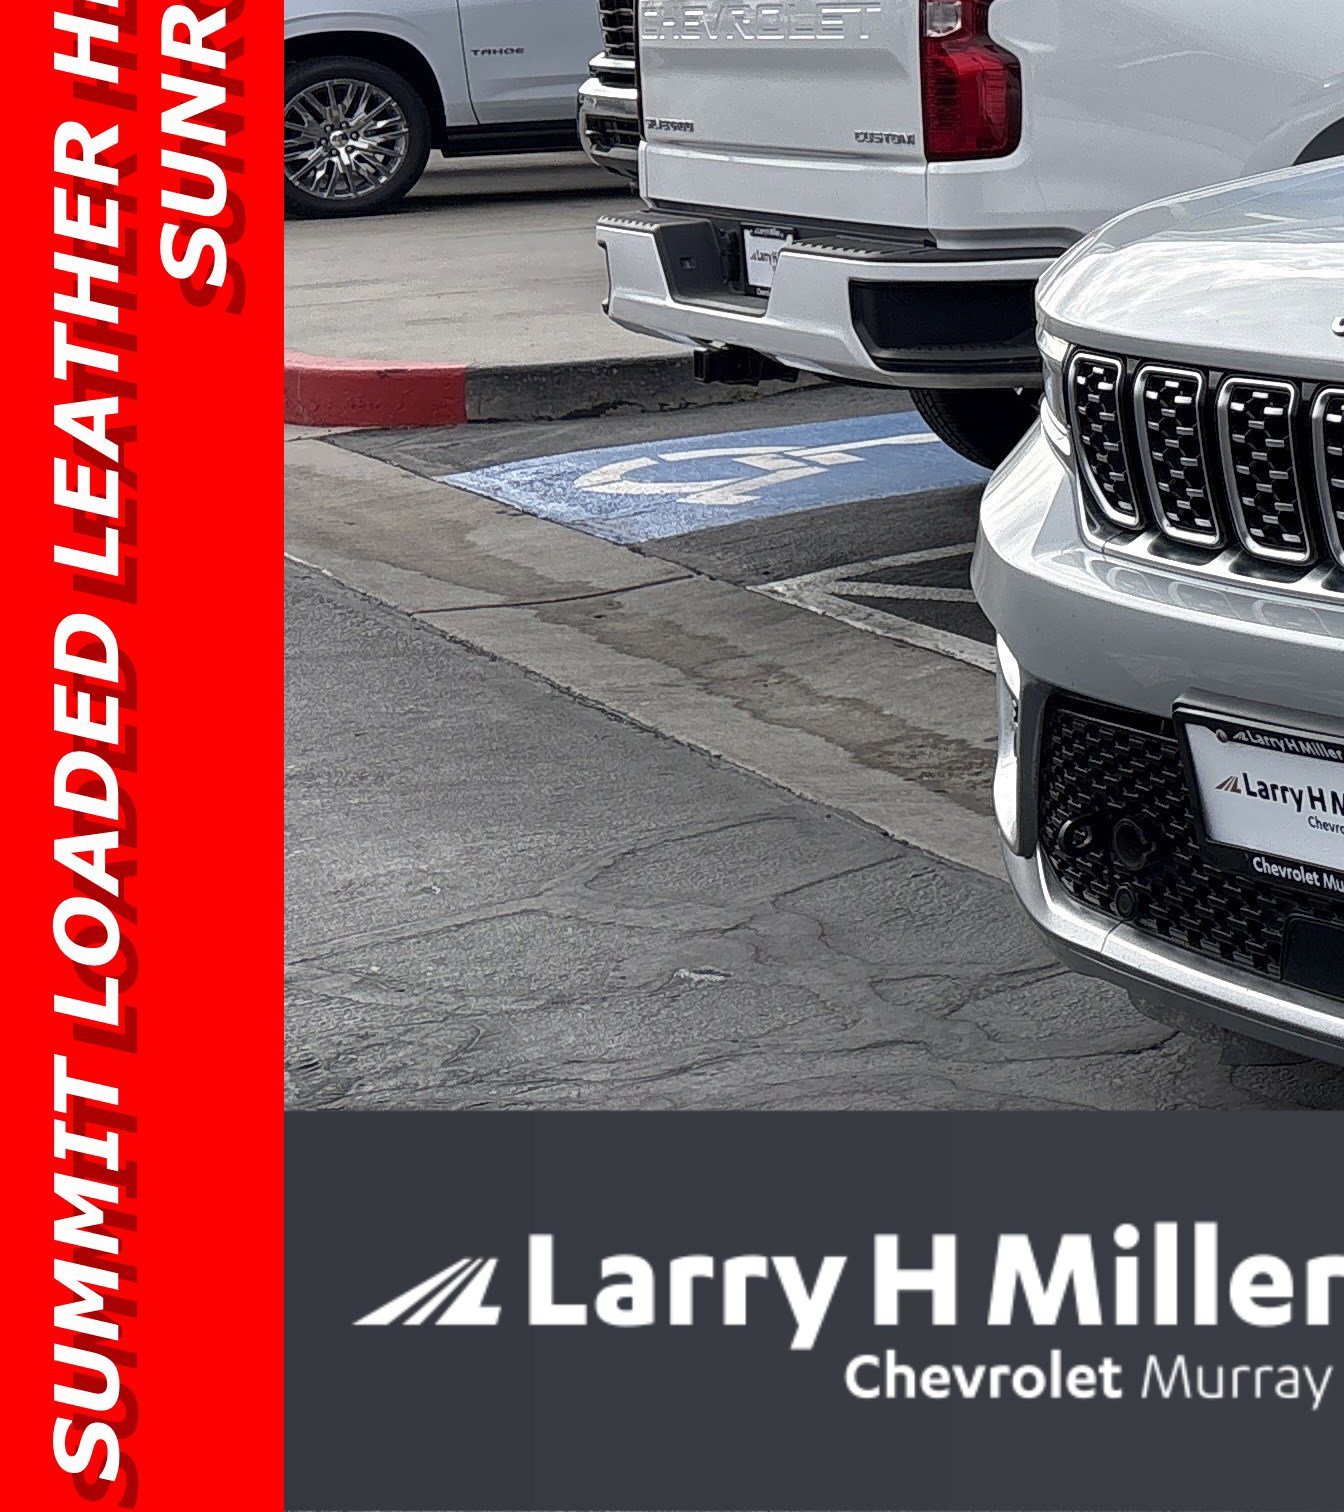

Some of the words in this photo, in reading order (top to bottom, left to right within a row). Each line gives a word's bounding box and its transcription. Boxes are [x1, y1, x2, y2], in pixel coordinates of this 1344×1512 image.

[640, 1, 882, 40] CHEVROLET
[470, 47, 526, 56] TAHOE
[854, 130, 917, 146] CUSTOM
[1245, 730, 1287, 752] Larry
[1242, 772, 1304, 813] Larry
[1306, 786, 1328, 813] H
[1252, 856, 1321, 887] Chevrolet
